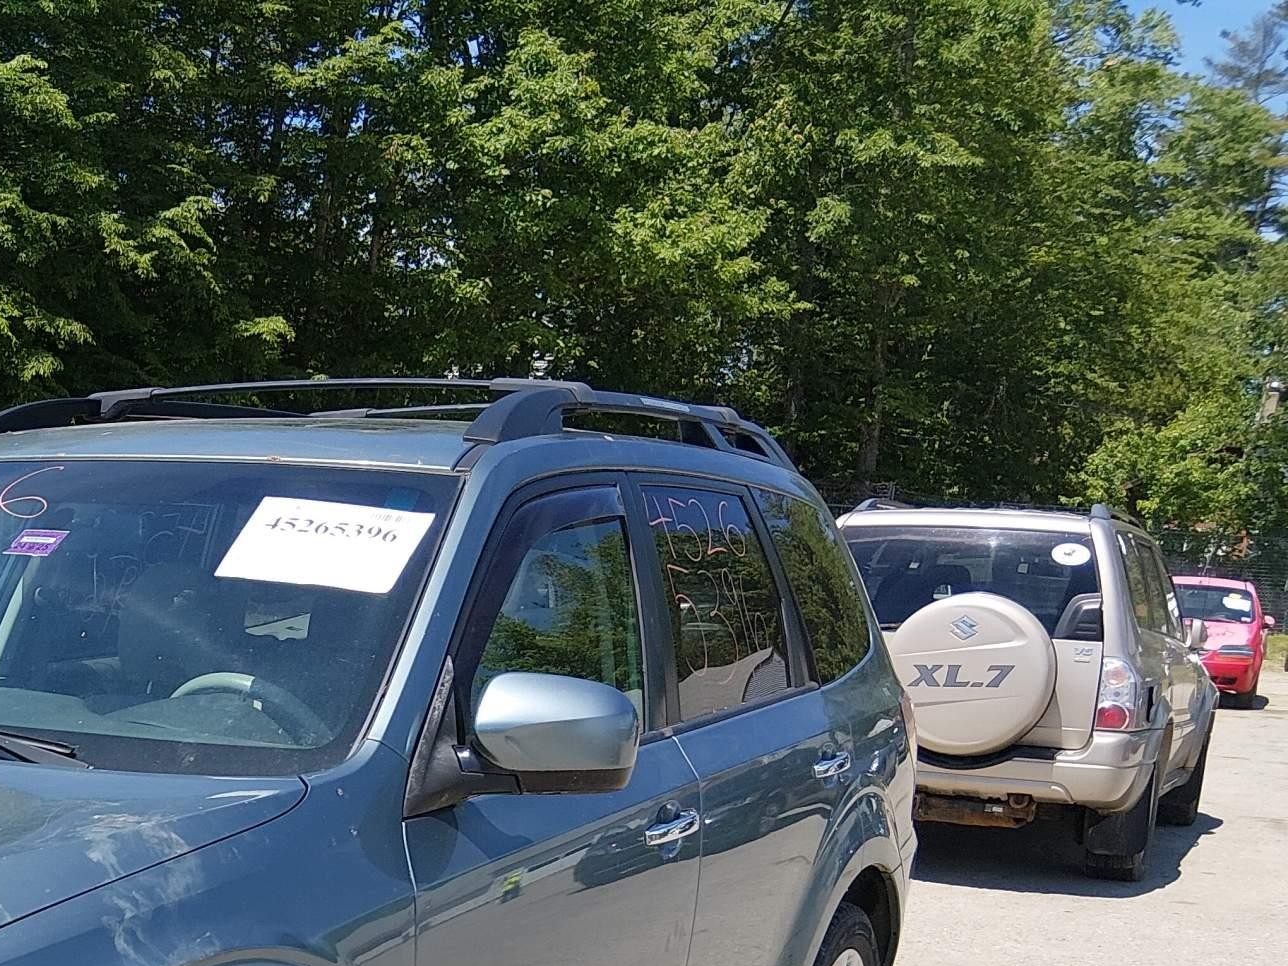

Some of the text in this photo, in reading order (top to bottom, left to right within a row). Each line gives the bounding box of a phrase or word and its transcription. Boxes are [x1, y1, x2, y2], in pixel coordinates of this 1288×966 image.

[264, 516, 398, 543] 45265396
[641, 492, 747, 562] 4526
[666, 563, 770, 685] 5396
